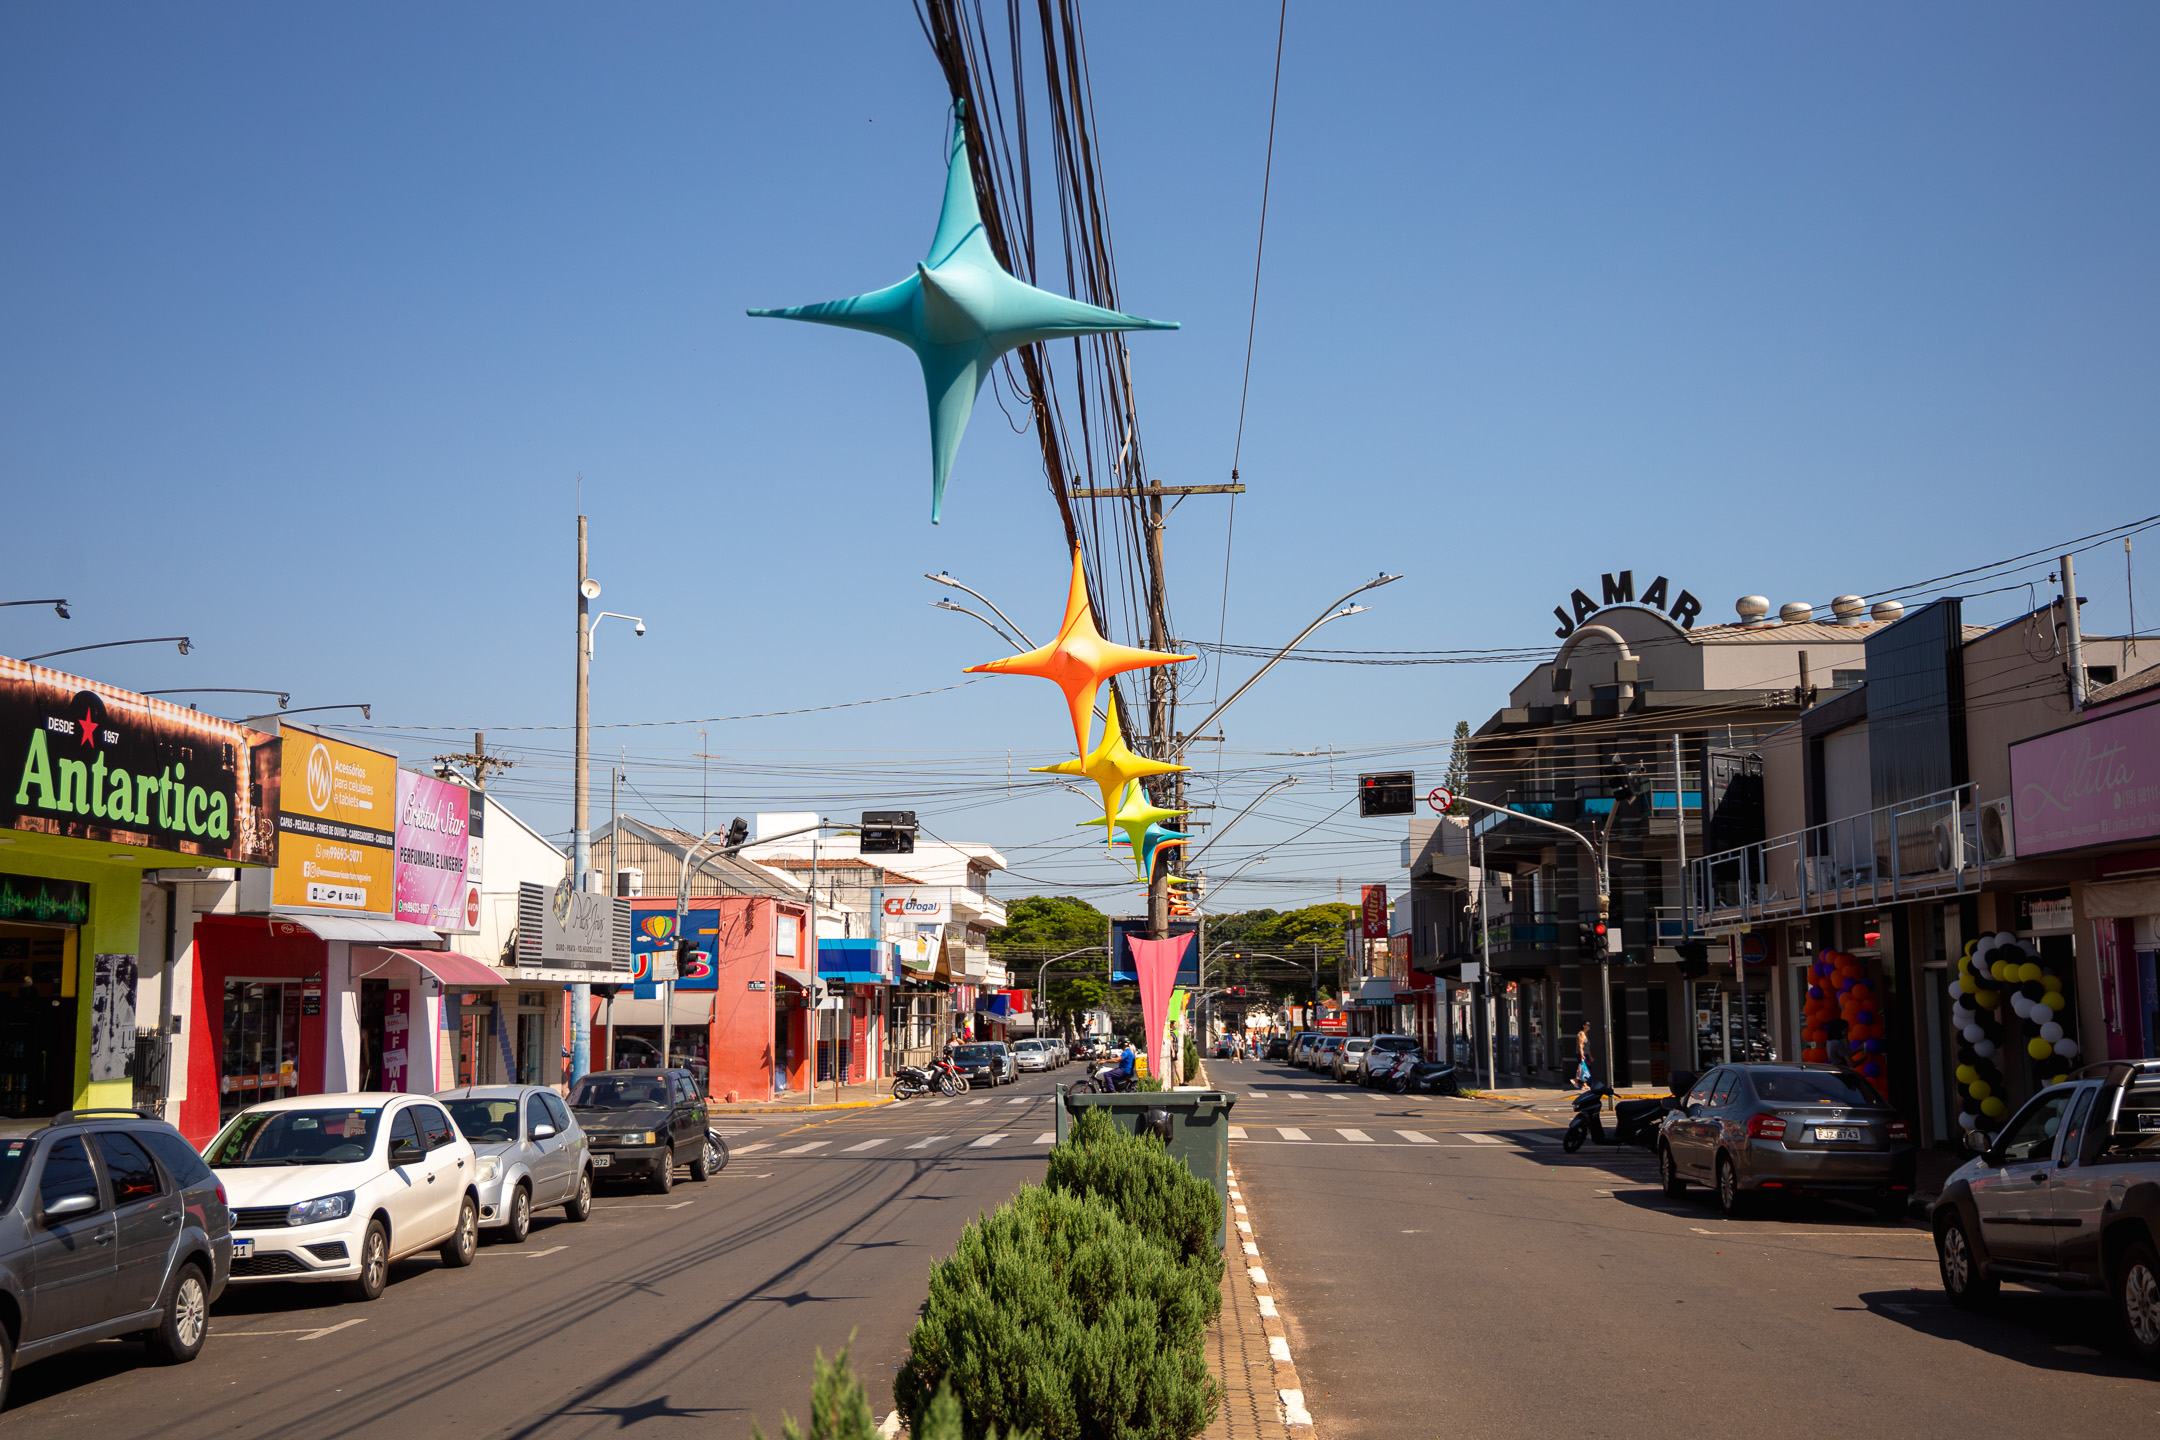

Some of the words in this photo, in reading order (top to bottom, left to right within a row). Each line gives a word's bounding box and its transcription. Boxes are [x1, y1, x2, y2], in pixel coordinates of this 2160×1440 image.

[1553, 570, 1703, 640] JAMAR
[48, 717, 75, 735] DESDE
[103, 730, 120, 745] 1957
[334, 760, 366, 779] Acessórios
[2018, 737, 2135, 822] Lolitta
[16, 728, 231, 840] Antartica
[334, 777, 348, 791] para
[348, 779, 374, 796] celulares
[334, 793, 338, 803] e
[338, 792, 359, 808] tablets
[294, 818, 315, 832] PELÍCULAS
[403, 792, 442, 832] Cristal
[440, 801, 466, 837] Star
[400, 846, 435, 868] PERFUMARIA
[435, 853, 440, 869] E
[905, 902, 937, 912] Drogal
[1367, 890, 1379, 923] Ultra
